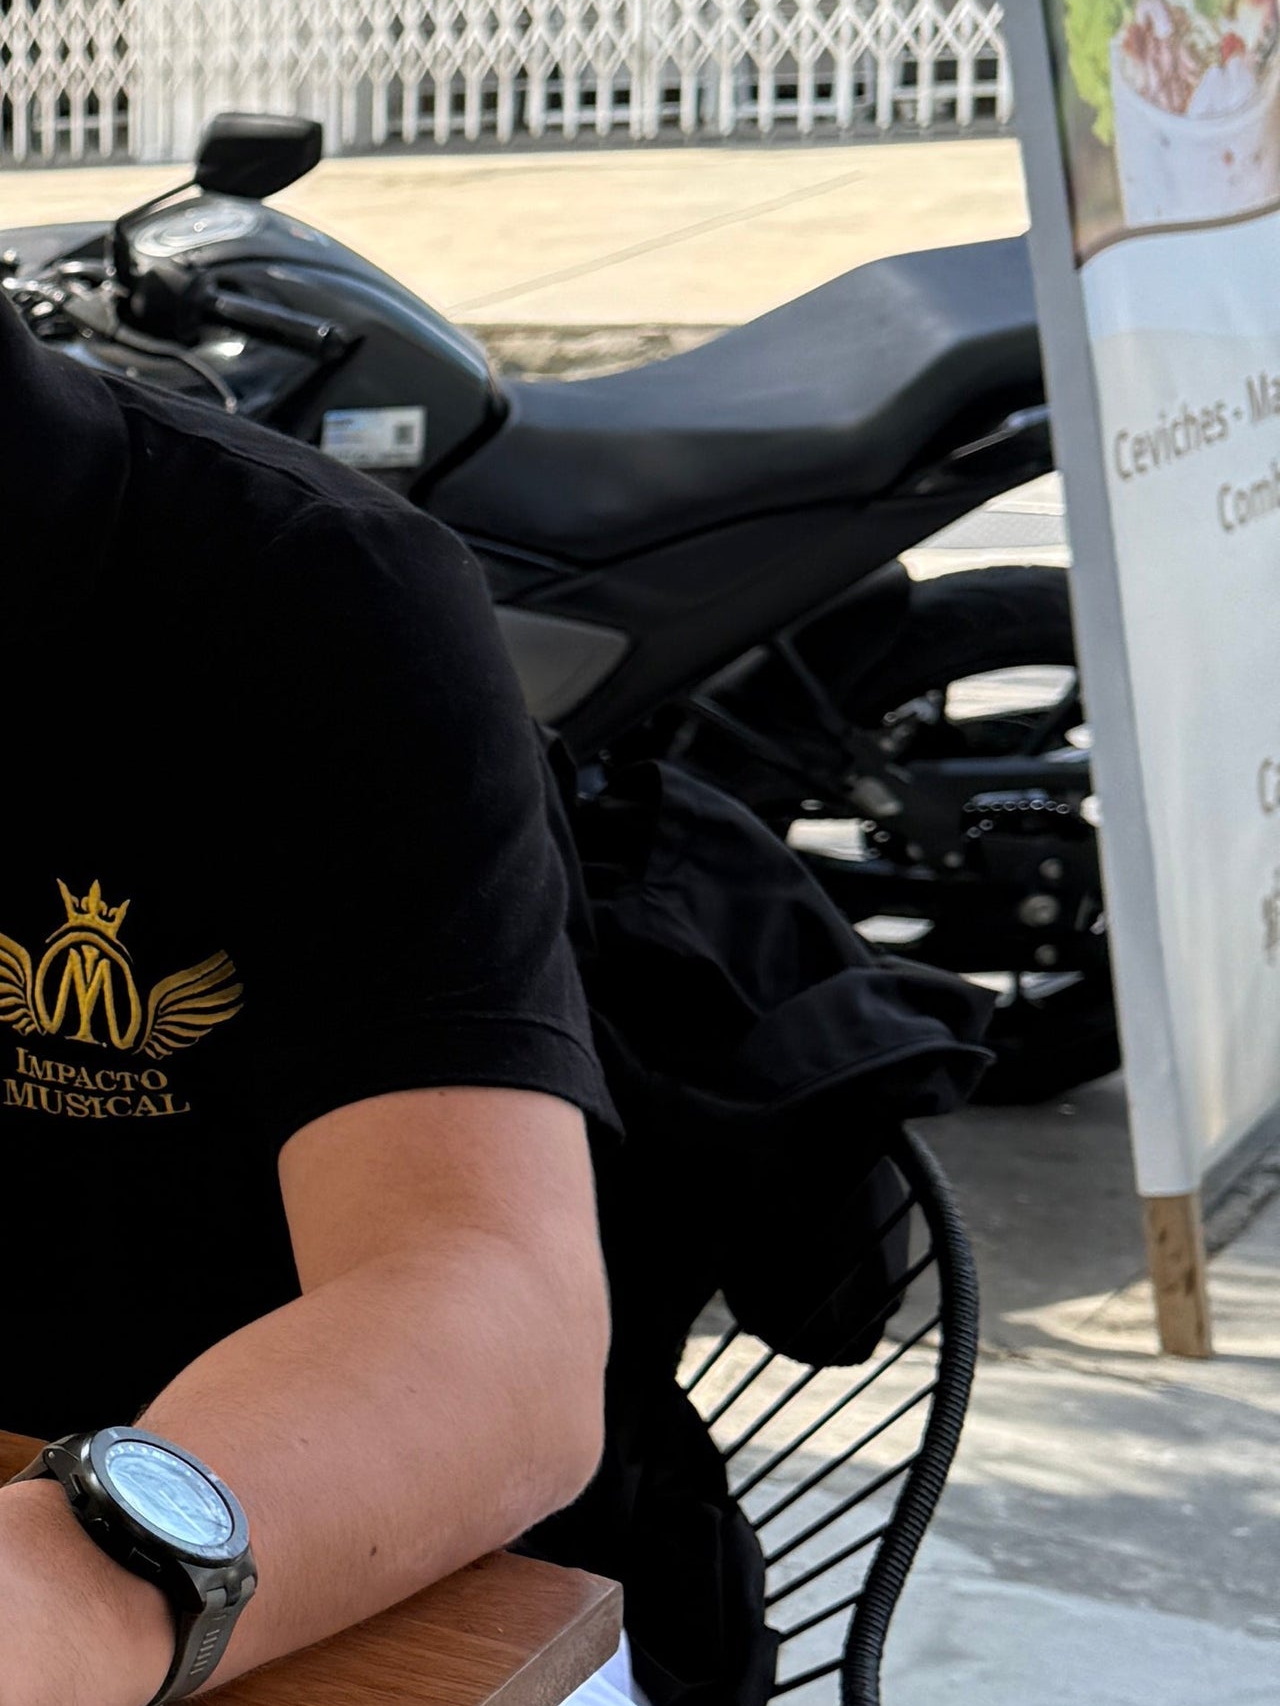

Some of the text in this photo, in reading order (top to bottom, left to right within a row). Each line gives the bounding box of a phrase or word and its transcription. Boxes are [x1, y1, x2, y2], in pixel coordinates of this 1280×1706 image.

[1115, 399, 1229, 481] Ceviches
[15, 1046, 169, 1092] IMPACTO
[4, 1078, 190, 1119] MUSICAL
